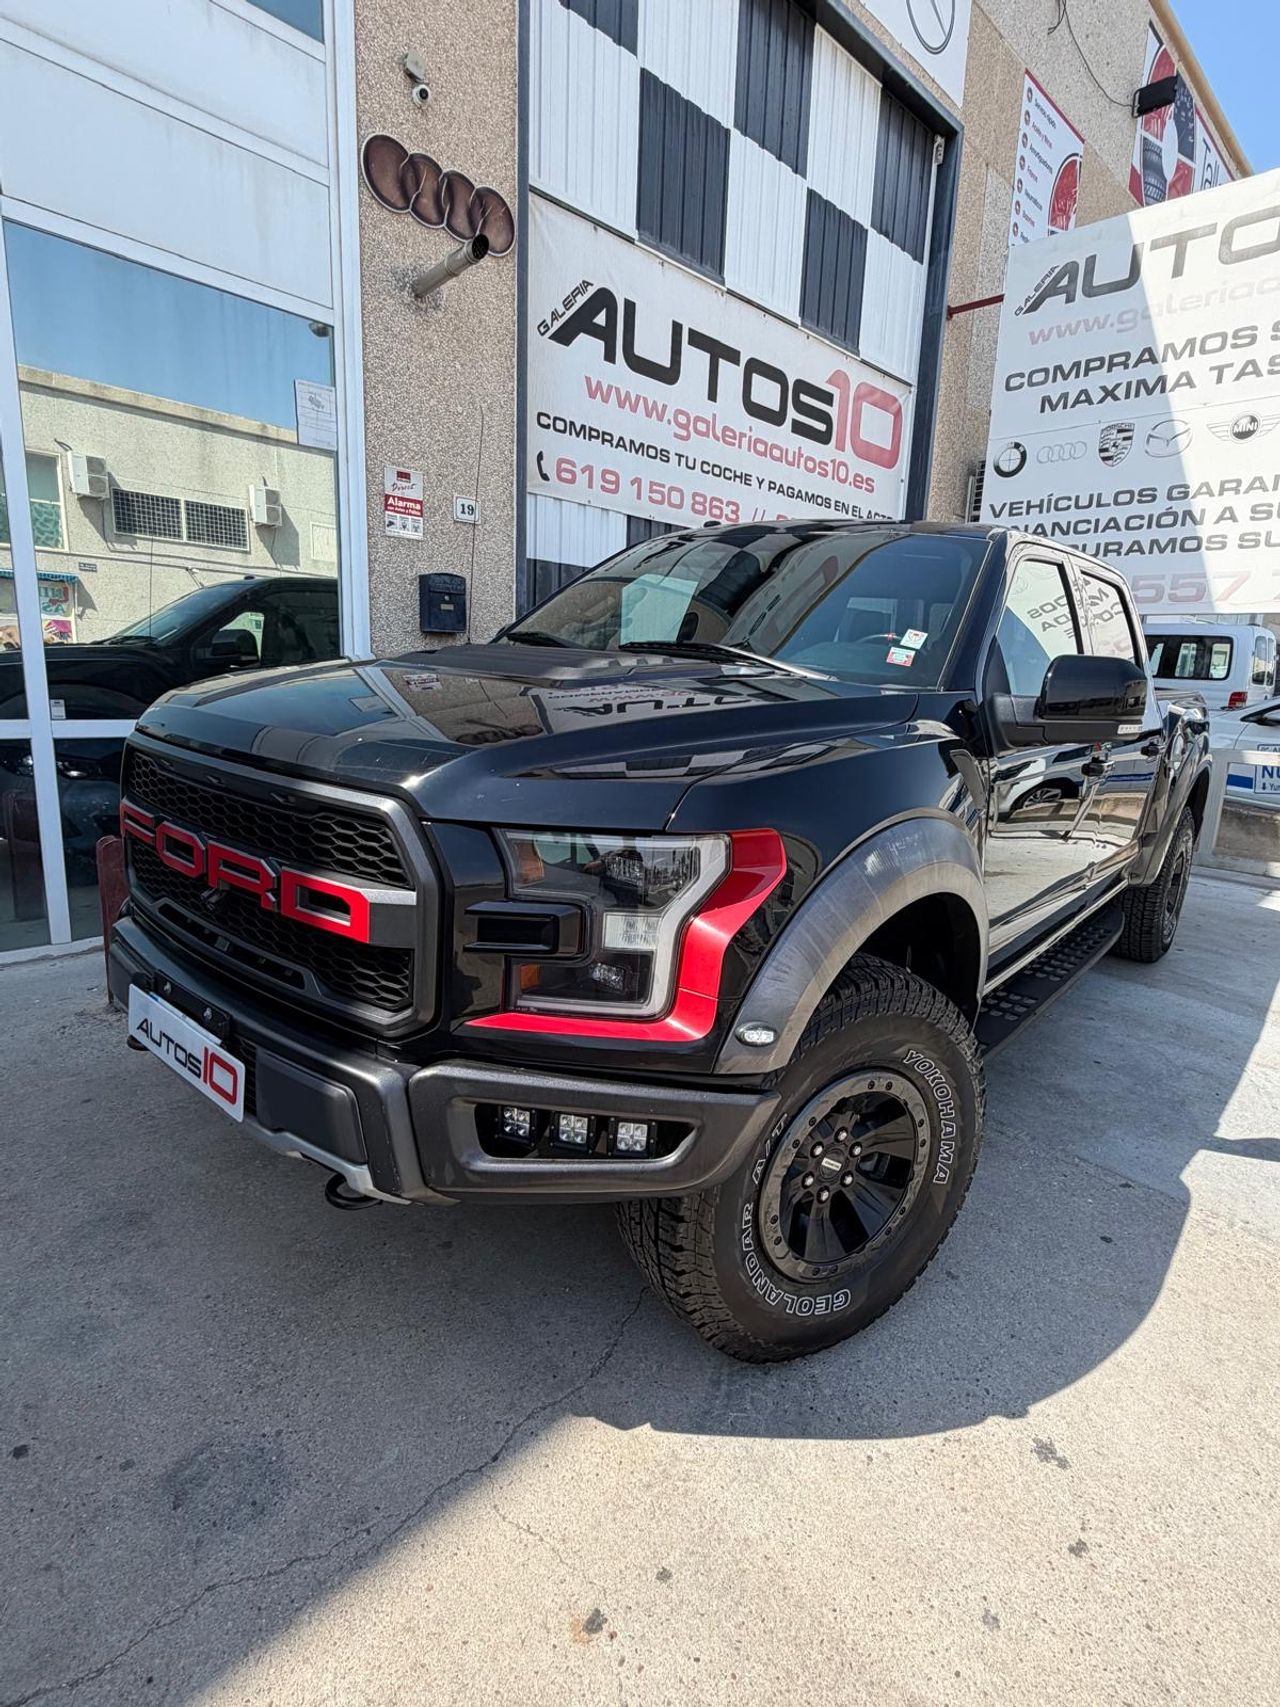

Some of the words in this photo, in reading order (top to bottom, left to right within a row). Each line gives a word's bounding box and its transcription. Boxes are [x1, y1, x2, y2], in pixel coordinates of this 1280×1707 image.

[537, 279, 594, 338] GALERIA
[1014, 264, 1060, 317] GALERIA
[547, 286, 903, 470] AUTOS10
[1004, 325, 1259, 392] COMPRAMOS
[1039, 370, 1197, 414] MAXIMA
[584, 375, 876, 494] www.galeriaautos10.es
[1232, 420, 1259, 434] MINI
[537, 411, 671, 464] COMPRAMOS
[675, 452, 696, 471] TU
[700, 460, 753, 487] COCHE
[756, 475, 766, 490] Y
[768, 481, 832, 510] PAGAMOS
[834, 500, 850, 516] EN
[851, 504, 864, 519] EL
[555, 457, 621, 495] 619
[630, 476, 685, 510] 150
[691, 490, 740, 524] 863
[387, 496, 421, 511] Alarma
[460, 503, 475, 516] 19
[989, 486, 1157, 519] VEHÍCULOS
[1010, 506, 1207, 538] ANCIACIÓN
[1213, 505, 1239, 525] A
[120, 804, 371, 944] FORD
[136, 1018, 238, 1106] AUTOS10
[903, 1049, 956, 1185] YOKOHAMA
[742, 1202, 852, 1316] GEOLANDAR
